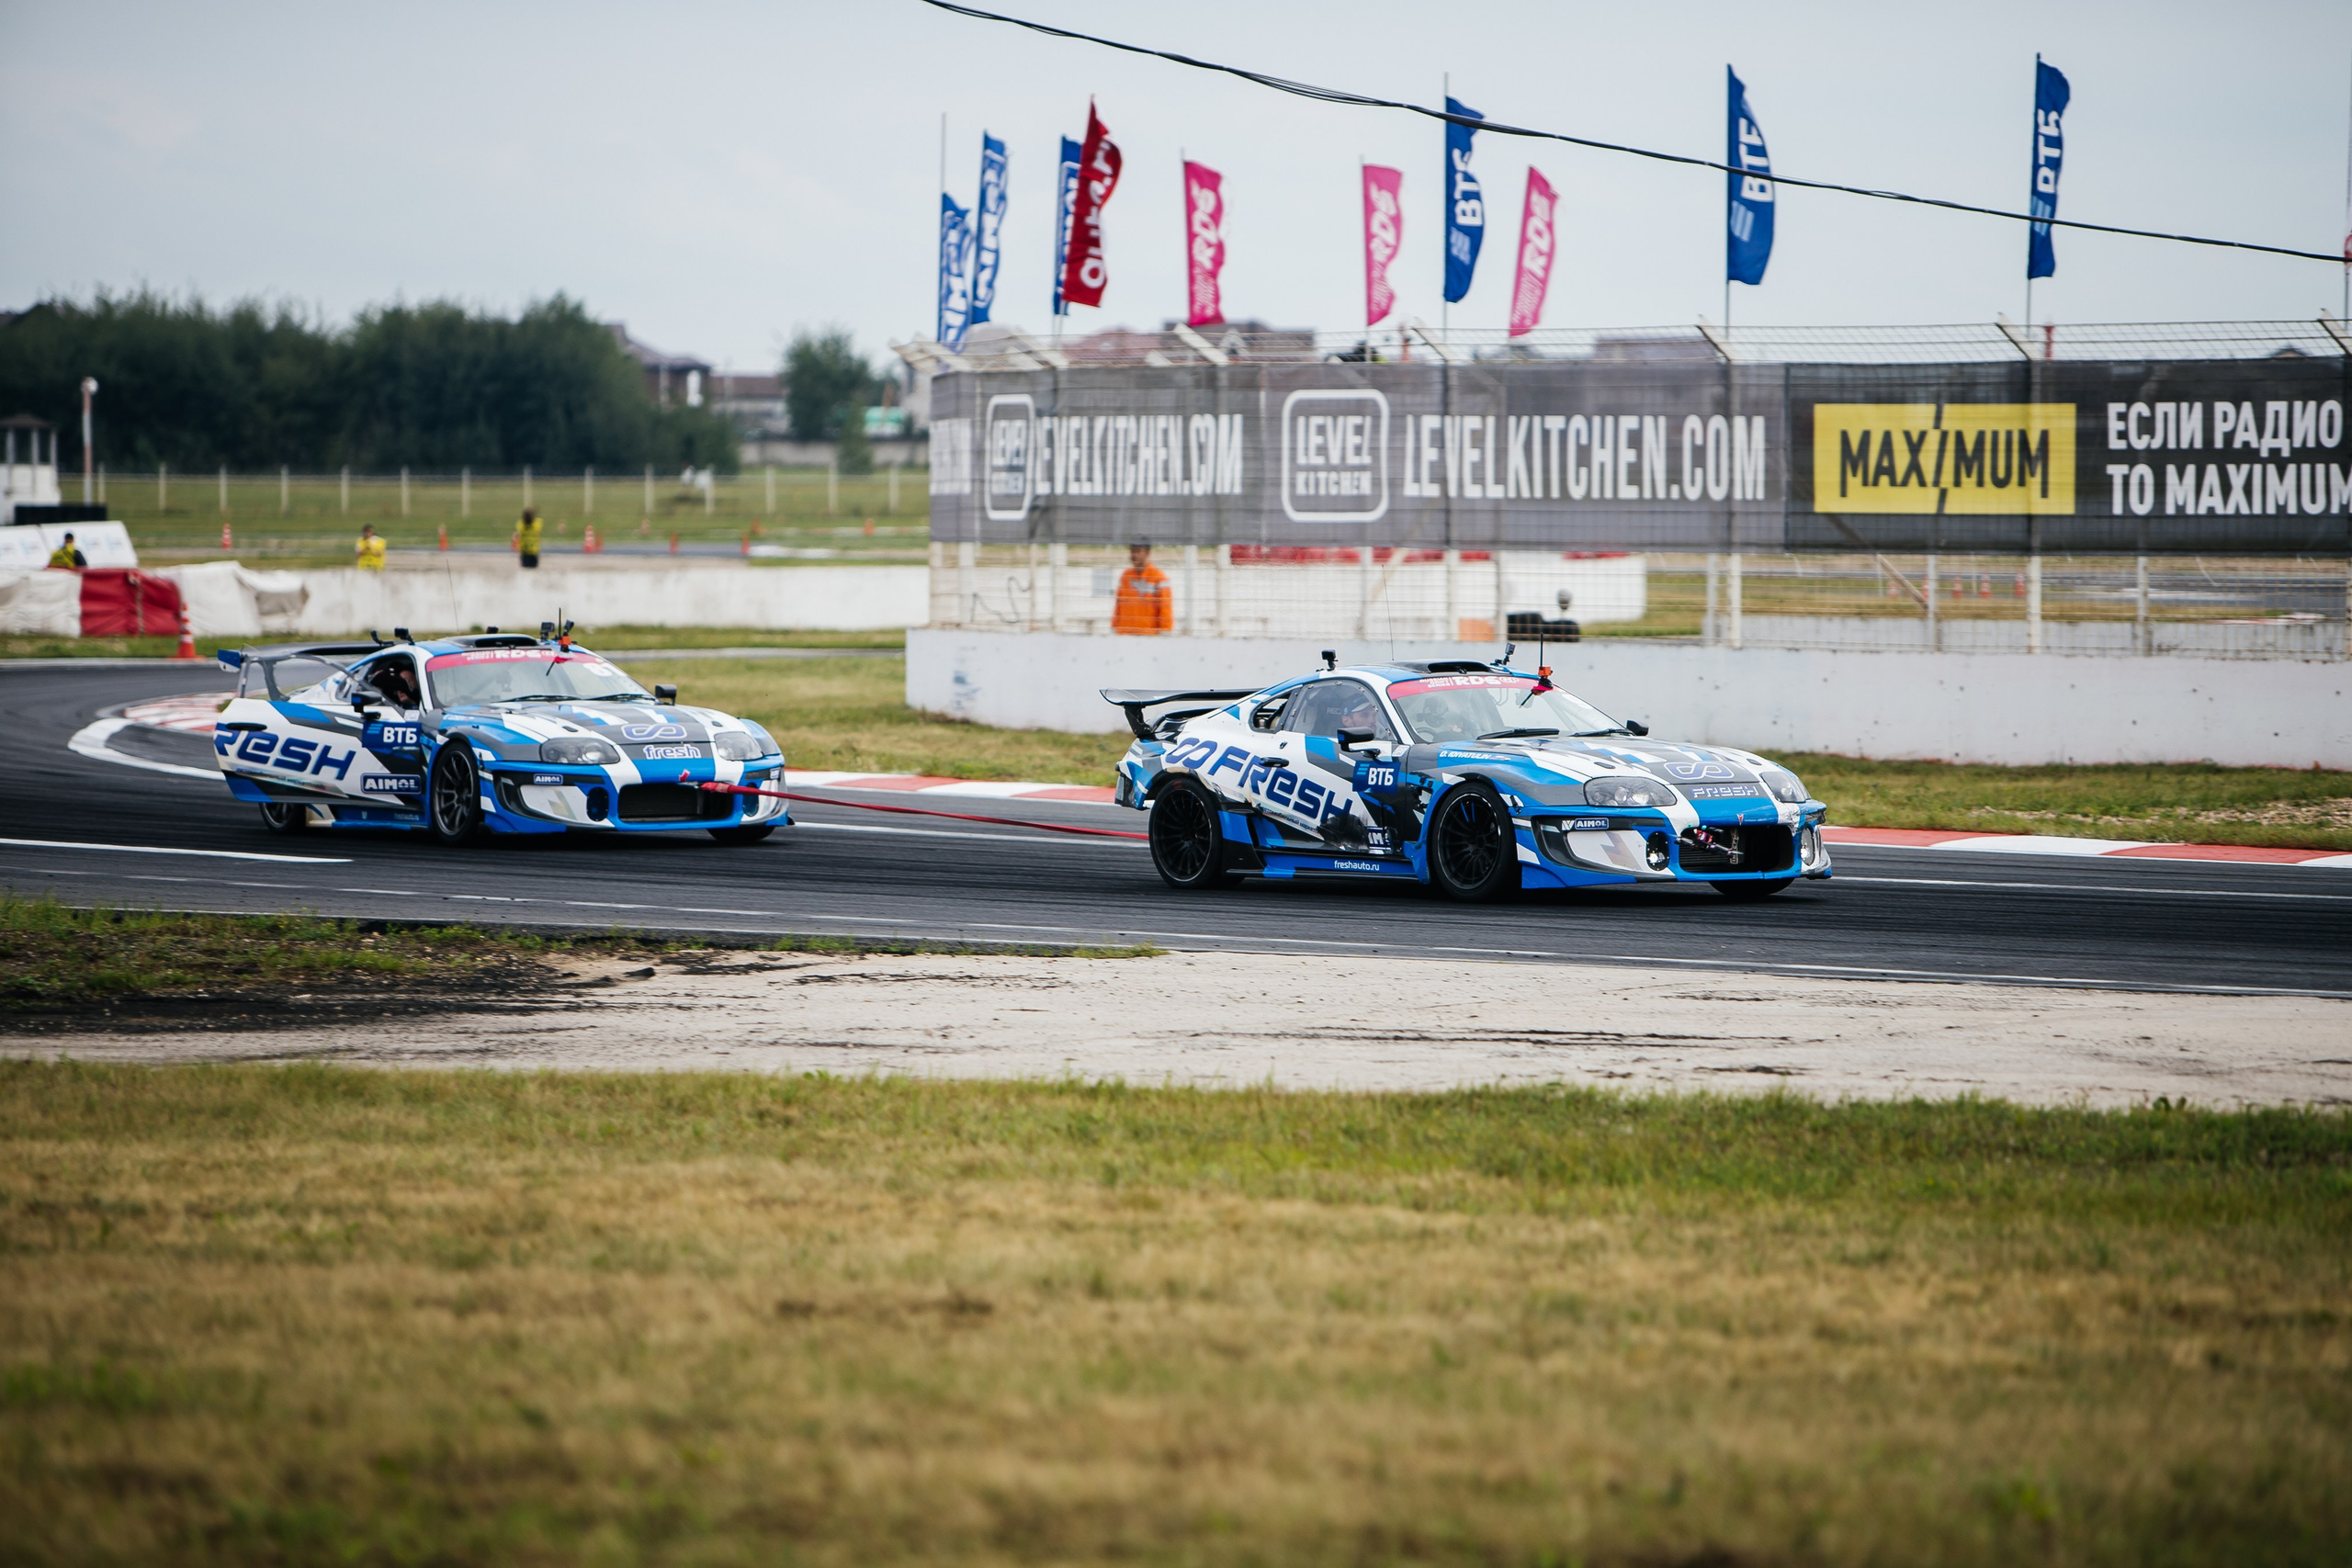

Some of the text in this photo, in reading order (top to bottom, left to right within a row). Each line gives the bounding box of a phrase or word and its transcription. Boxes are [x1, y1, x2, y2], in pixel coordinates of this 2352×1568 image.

[1522, 187, 1550, 278] RDS
[2107, 400, 2342, 457] ЕСЛИ РАДИО
[1295, 414, 1372, 466] LEVEL
[1404, 413, 1766, 502] LEVELKITCHEN.COM
[1295, 470, 1372, 496] KITCHEN
[2106, 463, 2352, 515] ТО MAXIMUM
[1452, 675, 1500, 685] RDS
[383, 727, 417, 744] ВТБ
[644, 744, 701, 760] fresh
[365, 778, 418, 790] AIMOL
[1368, 767, 1395, 785] ВТБ
[1577, 819, 1606, 828] AIMOL
[1334, 860, 1380, 871] freshauto.ru
